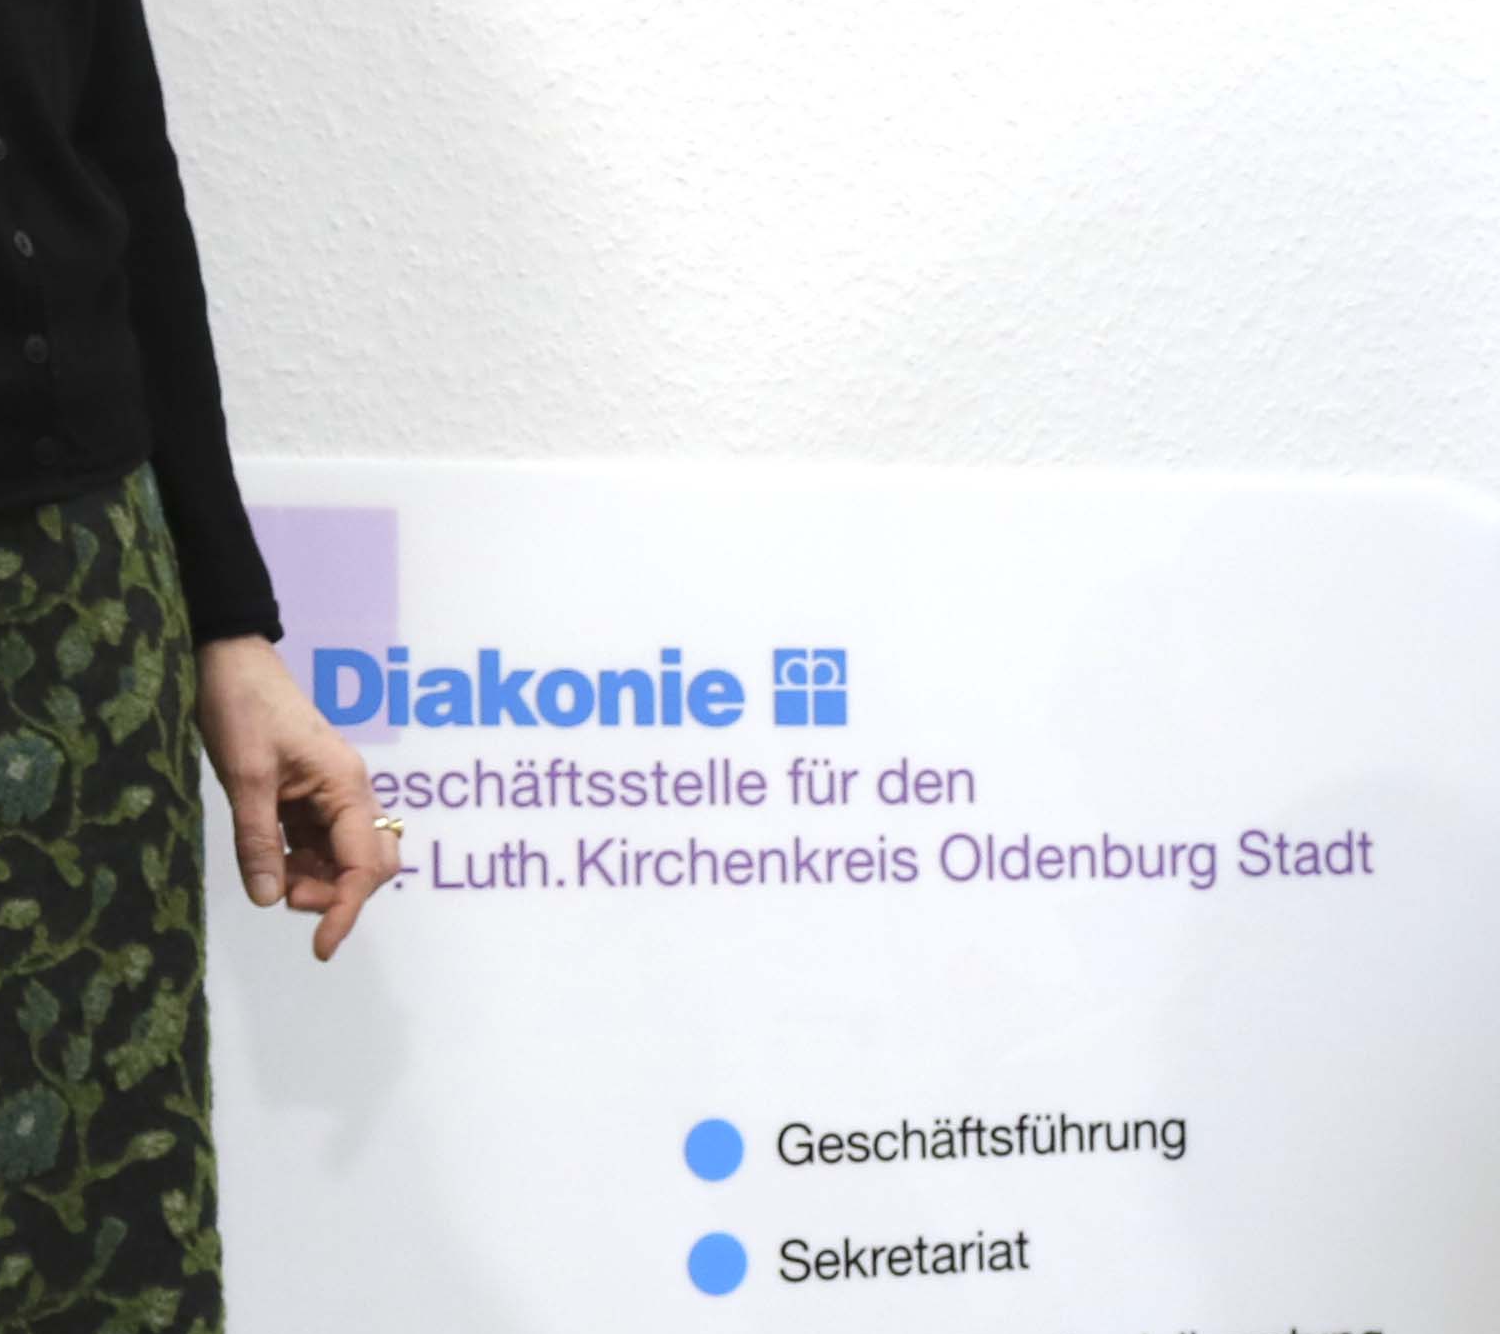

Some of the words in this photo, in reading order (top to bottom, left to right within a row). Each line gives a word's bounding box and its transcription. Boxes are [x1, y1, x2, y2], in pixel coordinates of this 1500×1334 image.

[314, 647, 746, 728] Diakonie
[372, 758, 767, 809] eschäftsstelle
[787, 757, 859, 806] für
[876, 757, 975, 805] den
[939, 832, 1217, 891] Oldenburg
[1238, 829, 1374, 878] Stadt
[776, 1112, 1187, 1167] Geschäftsführung
[778, 1230, 1030, 1284] Sekretariat
